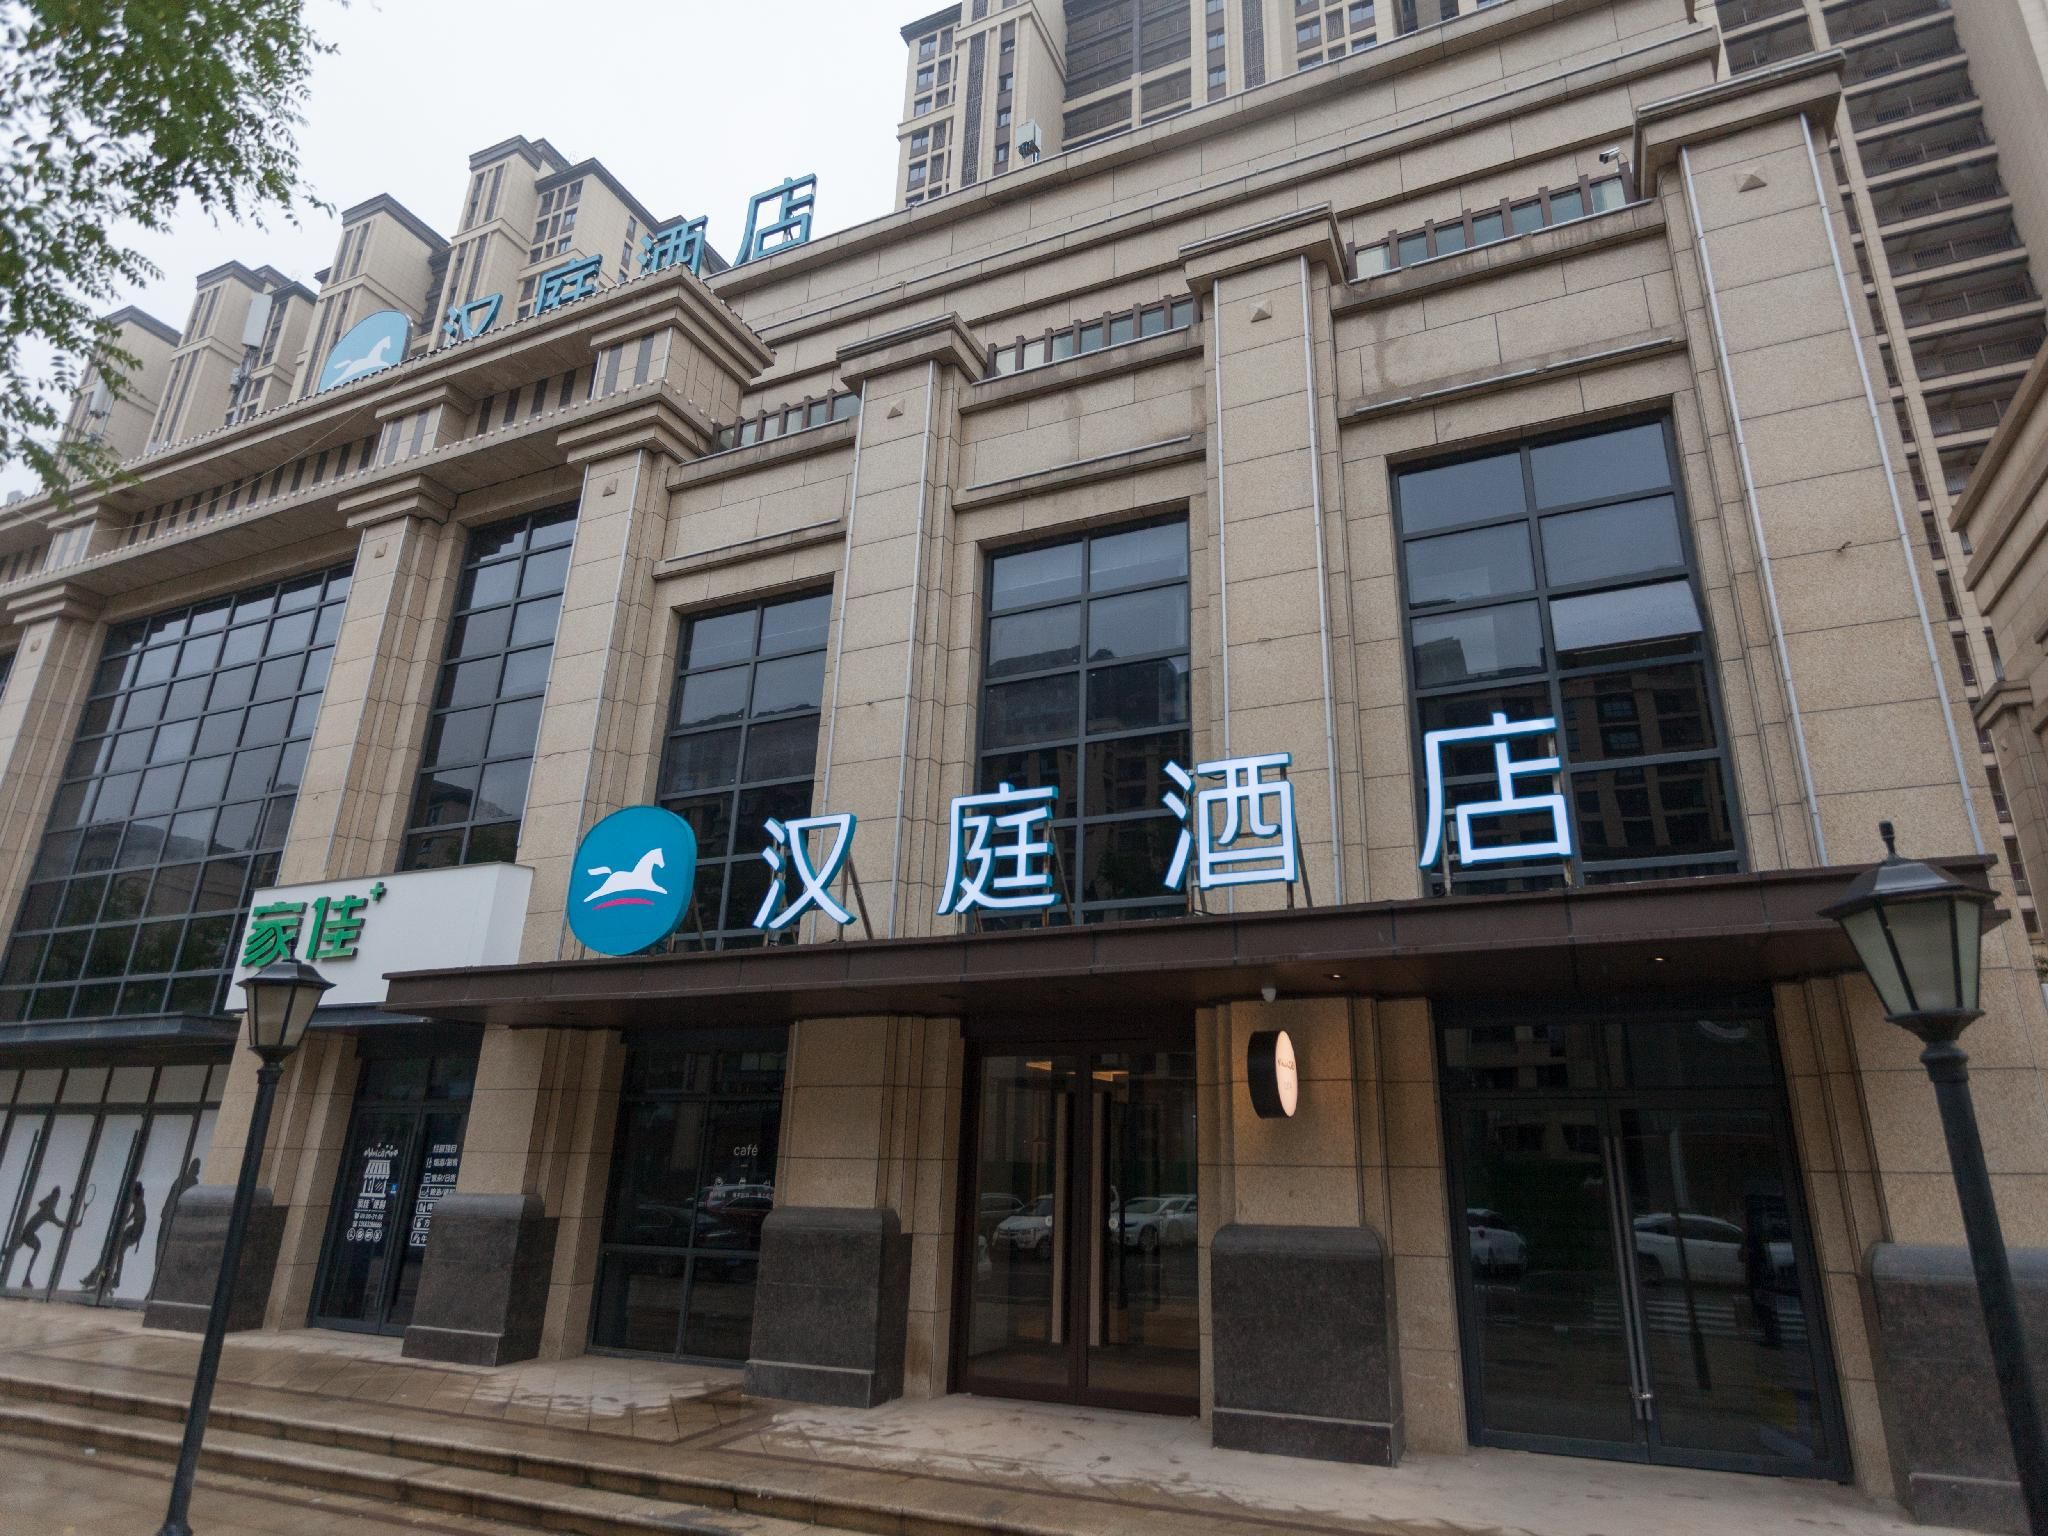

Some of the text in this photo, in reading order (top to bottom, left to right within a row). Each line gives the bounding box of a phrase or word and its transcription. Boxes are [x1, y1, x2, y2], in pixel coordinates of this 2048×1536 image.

[752, 711, 1574, 930] 汉庭酒店
[733, 1143, 759, 1157] café
